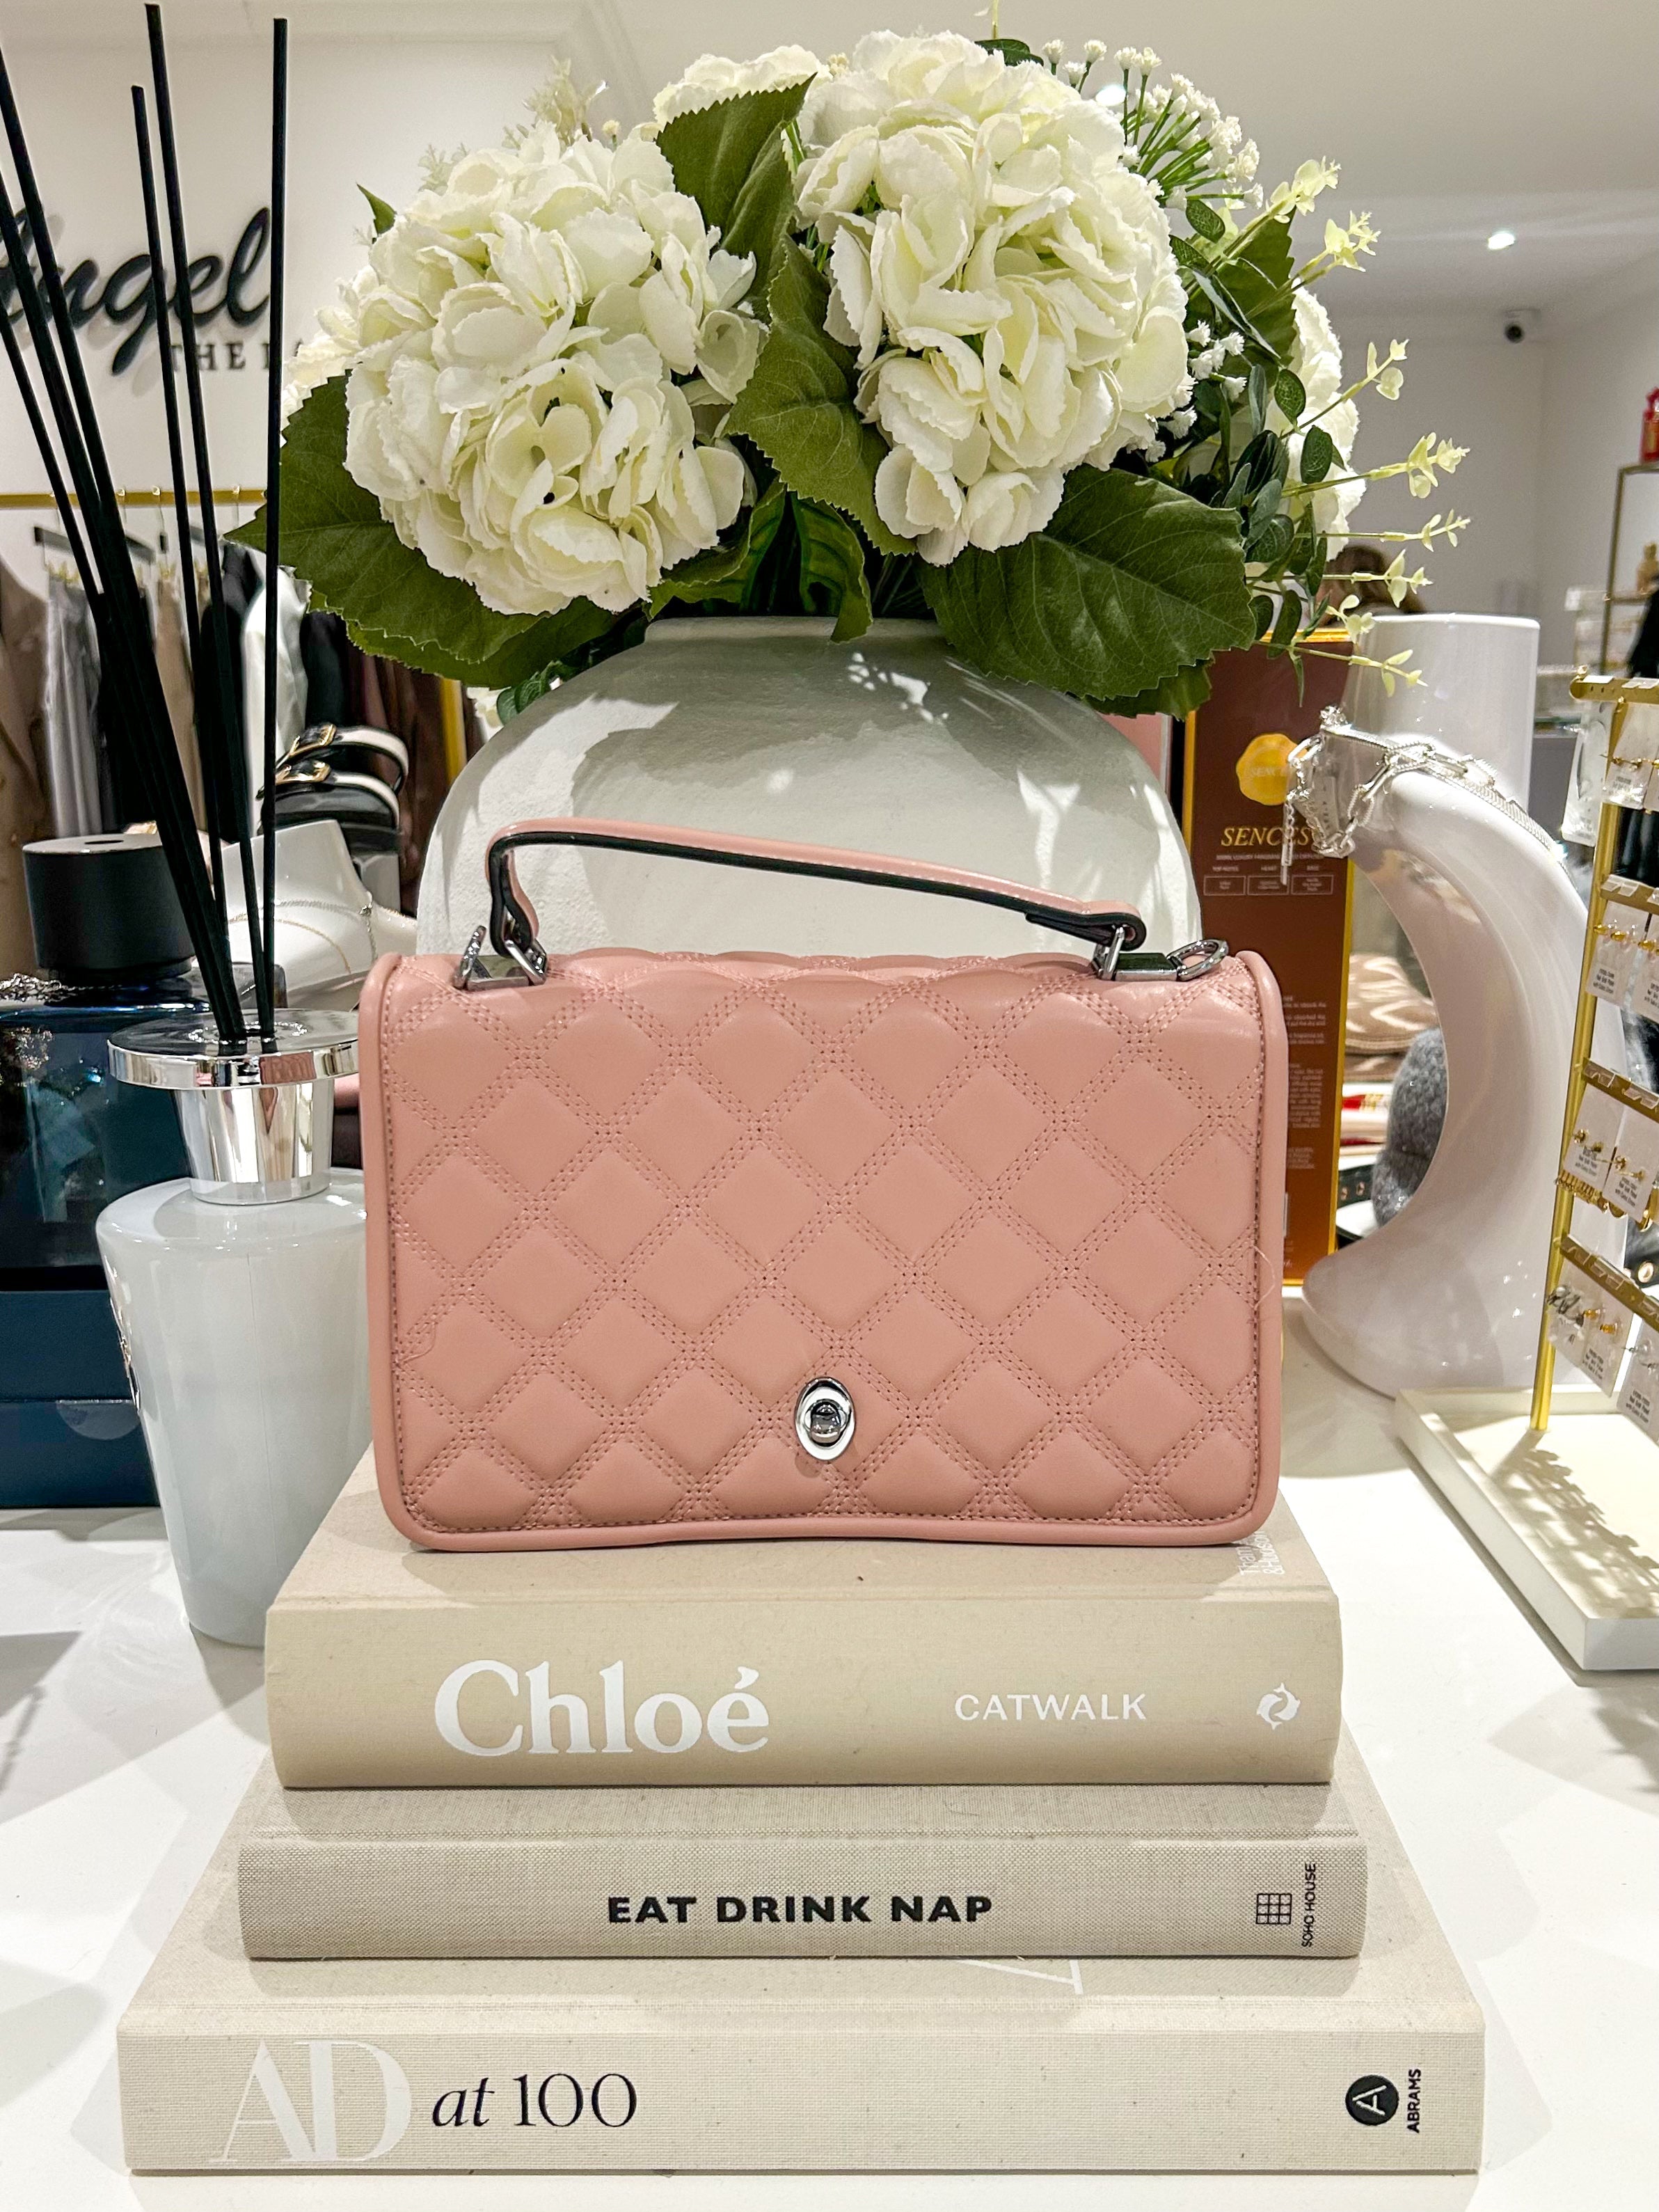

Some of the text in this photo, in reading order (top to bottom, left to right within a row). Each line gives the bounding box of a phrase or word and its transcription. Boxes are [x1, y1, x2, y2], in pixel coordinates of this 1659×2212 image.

[434, 1659, 769, 1756] Chloé
[954, 1693, 1147, 1721] CATWALK
[608, 1896, 992, 1923] EAT DRINK NAP
[1301, 1863, 1317, 1948] SOHO HOUSE
[209, 2038, 638, 2163] AD at 100
[1351, 2085, 1388, 2116] A
[1406, 2068, 1422, 2133] ABRAMS
